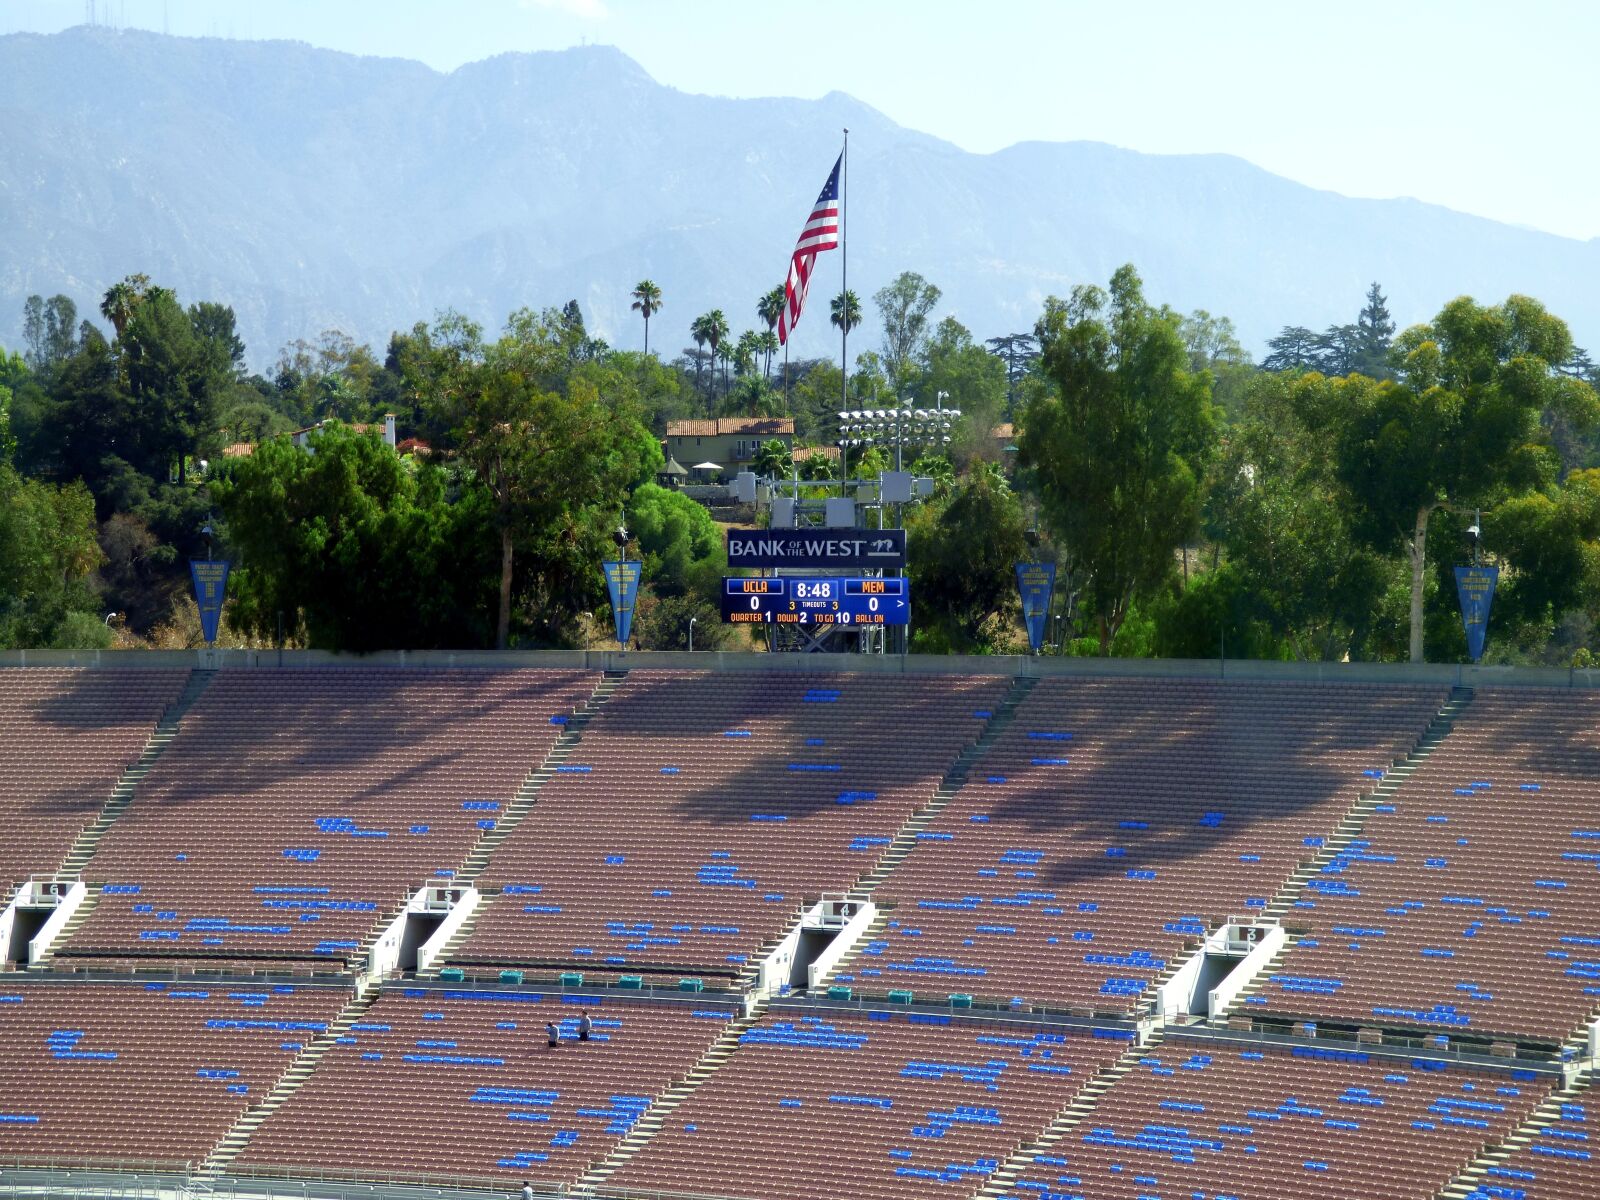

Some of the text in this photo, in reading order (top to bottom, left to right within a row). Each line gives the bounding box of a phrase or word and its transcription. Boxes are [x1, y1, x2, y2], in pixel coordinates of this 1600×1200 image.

[729, 540, 867, 556] BANK OF THE WEST
[743, 581, 768, 593] UCLA
[797, 582, 830, 598] 8:48
[862, 581, 885, 593] MEM
[750, 596, 760, 610] 0
[789, 601, 796, 610] 3
[832, 601, 839, 610] 3
[868, 597, 879, 611] 0
[730, 610, 771, 623] QUARTER 1
[777, 611, 808, 623] DOWN 2
[814, 611, 850, 624] TO GO 10
[855, 614, 884, 623] BALL ON
[49, 884, 58, 895] 6
[444, 890, 453, 901] 5
[841, 903, 850, 915] 4
[1247, 928, 1256, 940] 3
